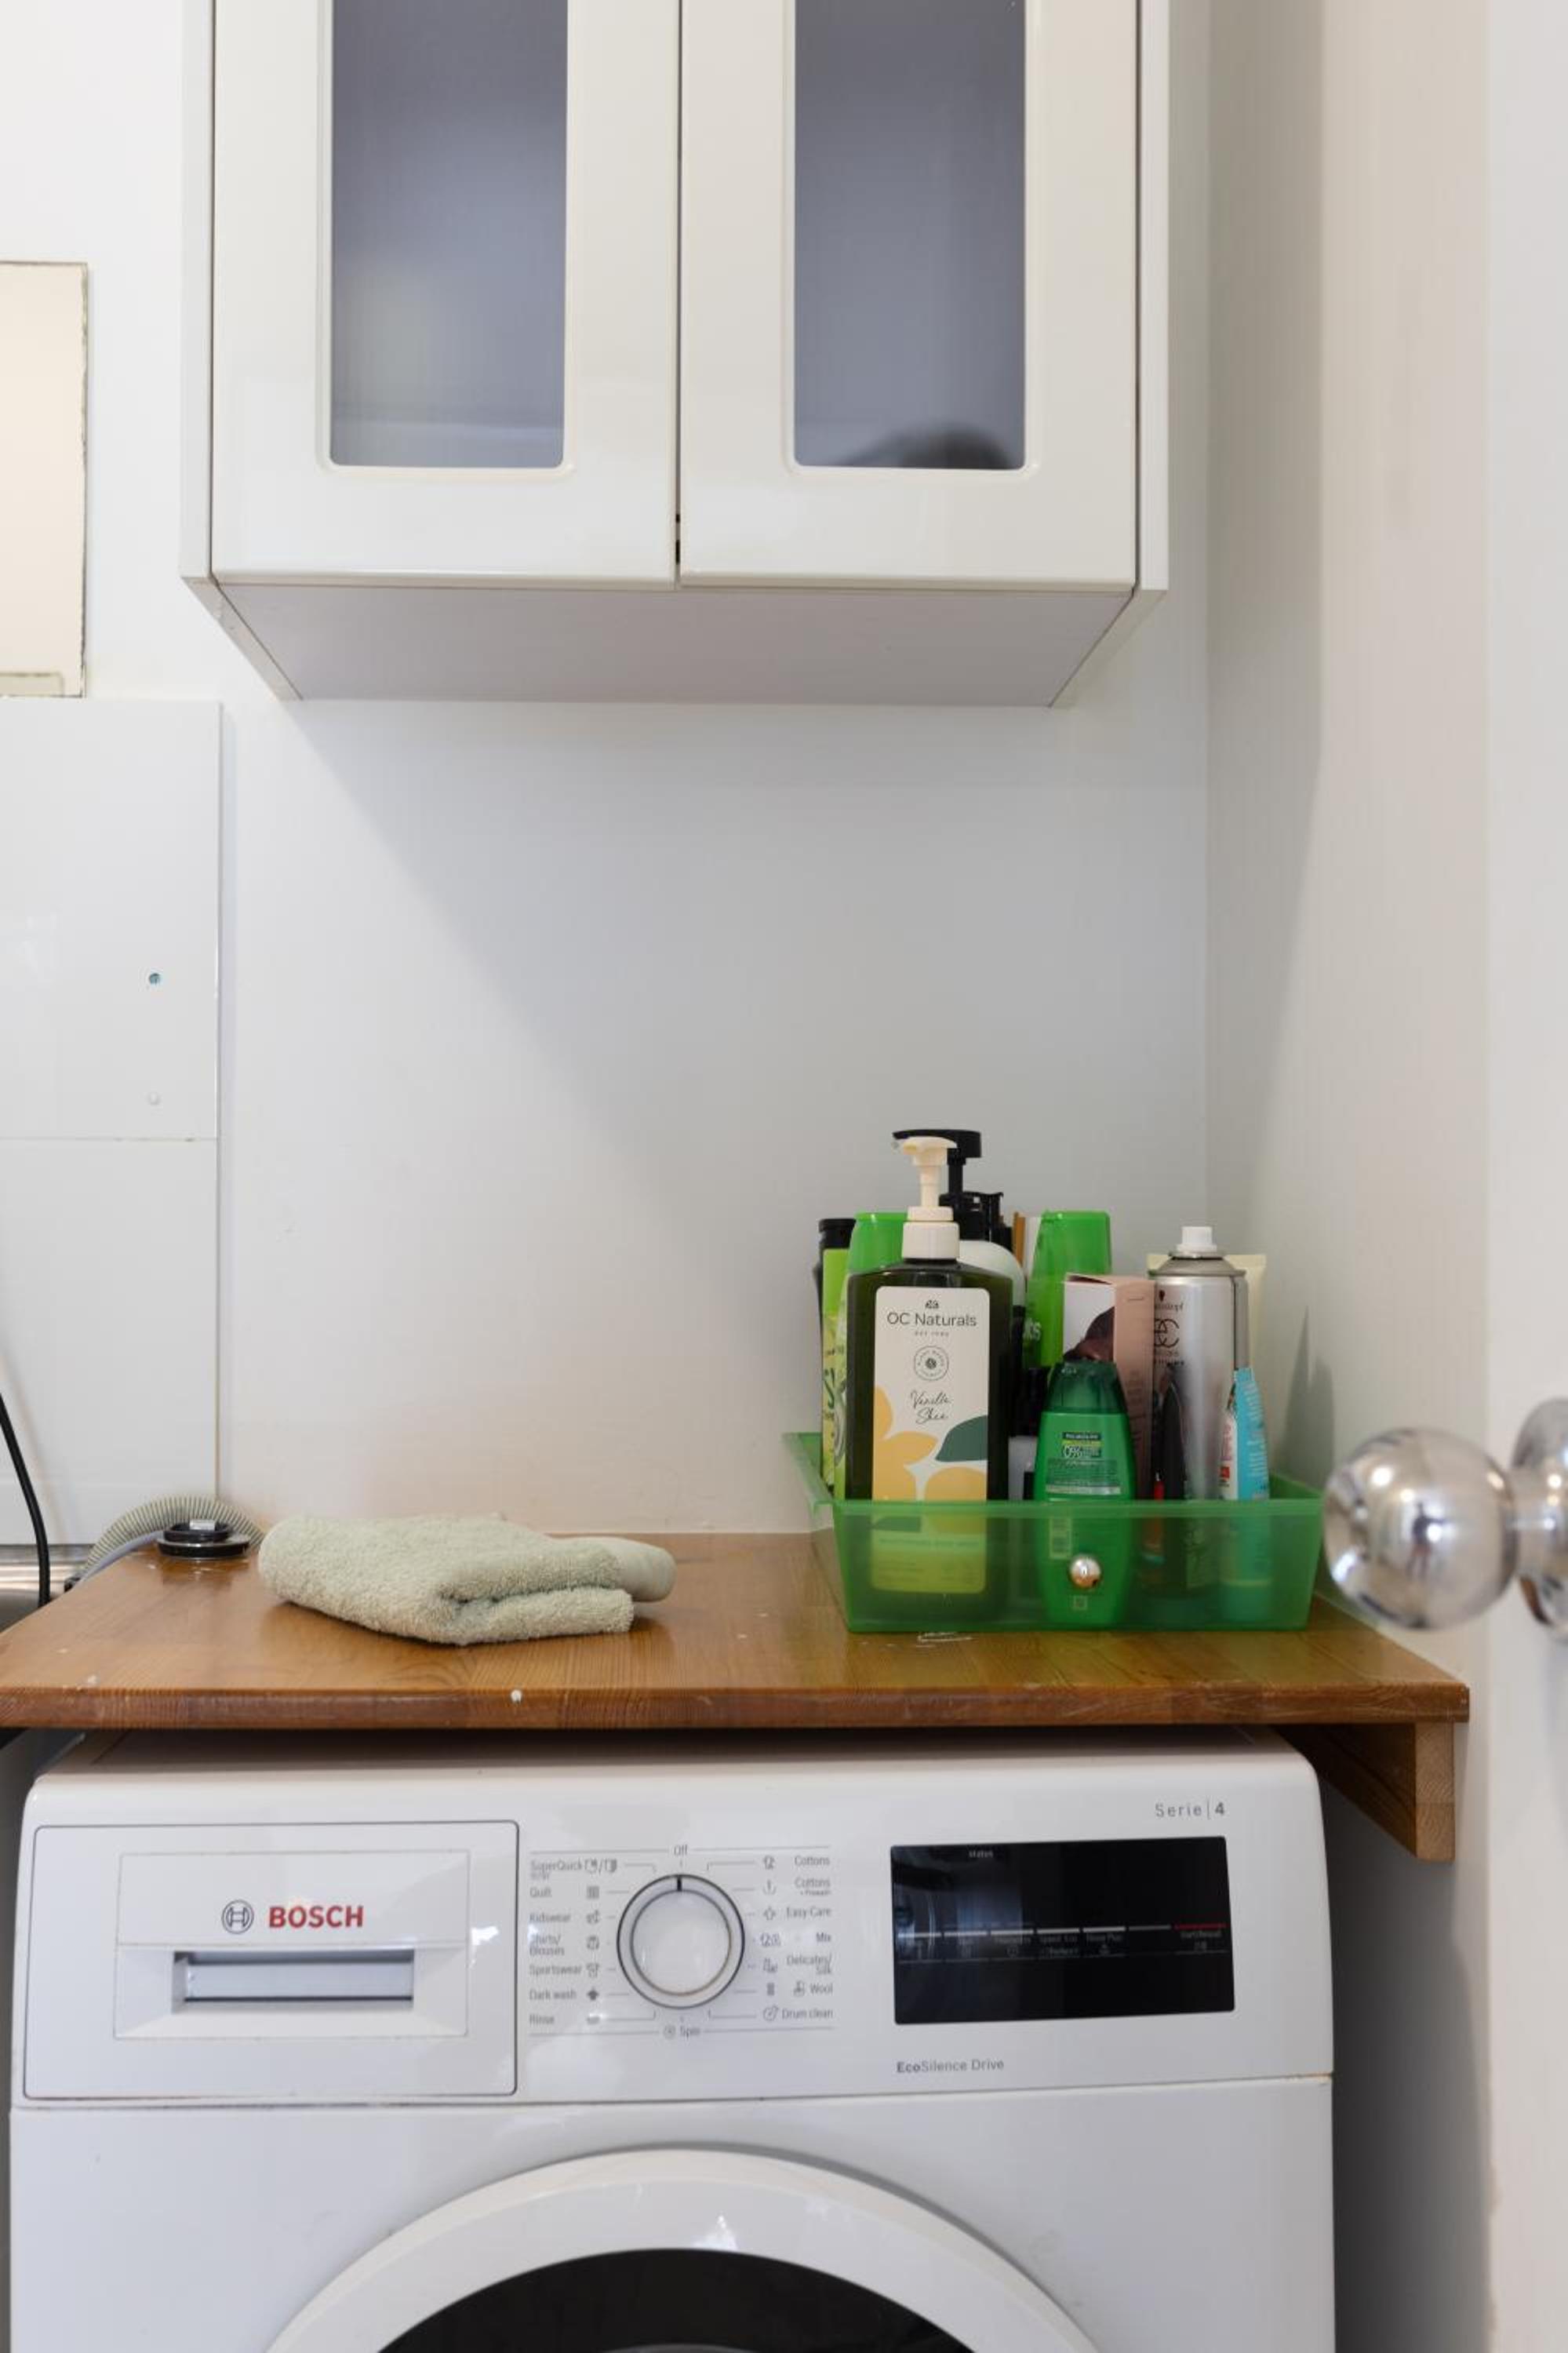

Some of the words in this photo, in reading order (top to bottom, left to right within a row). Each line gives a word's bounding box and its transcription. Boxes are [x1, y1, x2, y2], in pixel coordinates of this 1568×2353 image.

[887, 1312, 910, 1325] OC
[915, 1313, 977, 1326] Naturals
[1155, 1802, 1202, 1818] Serie
[268, 1905, 363, 1929] BOSCH
[896, 2058, 968, 2074] EcoSilence
[971, 2057, 1005, 2071] Drive
